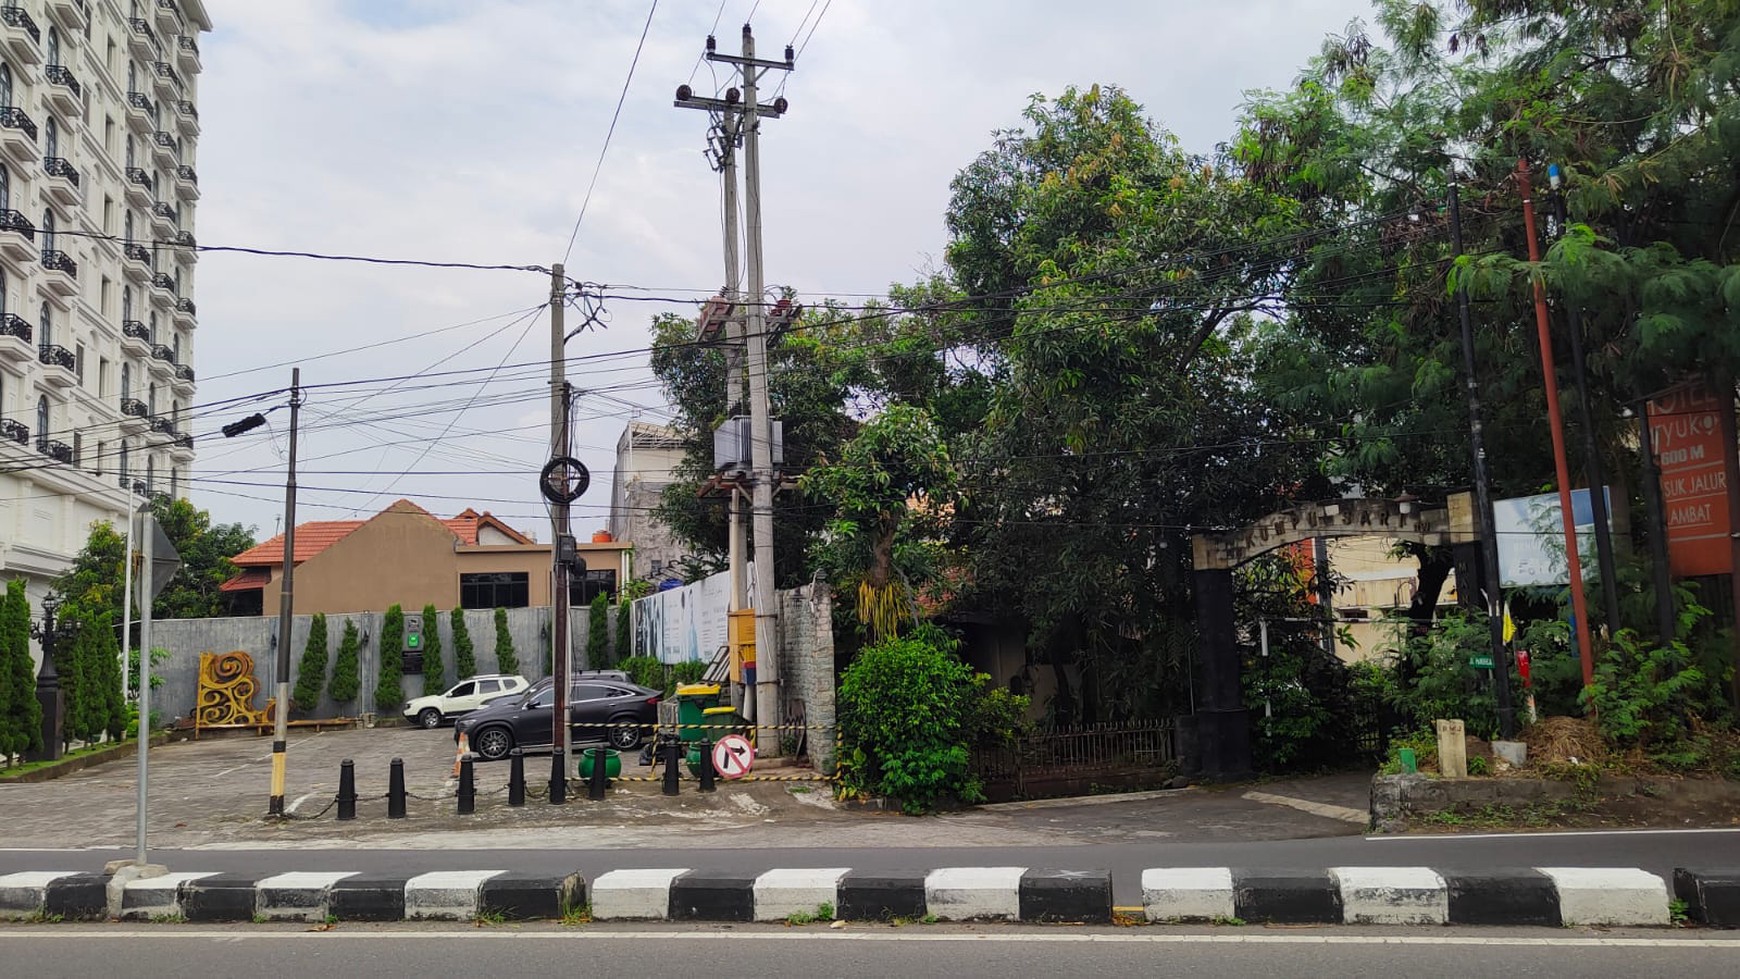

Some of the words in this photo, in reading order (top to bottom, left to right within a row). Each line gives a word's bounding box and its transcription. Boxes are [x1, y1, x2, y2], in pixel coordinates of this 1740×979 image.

[1661, 448, 1687, 465] 600
[1690, 445, 1704, 461] M
[1689, 472, 1727, 494] JALUR
[1667, 504, 1711, 525] AMBAT
